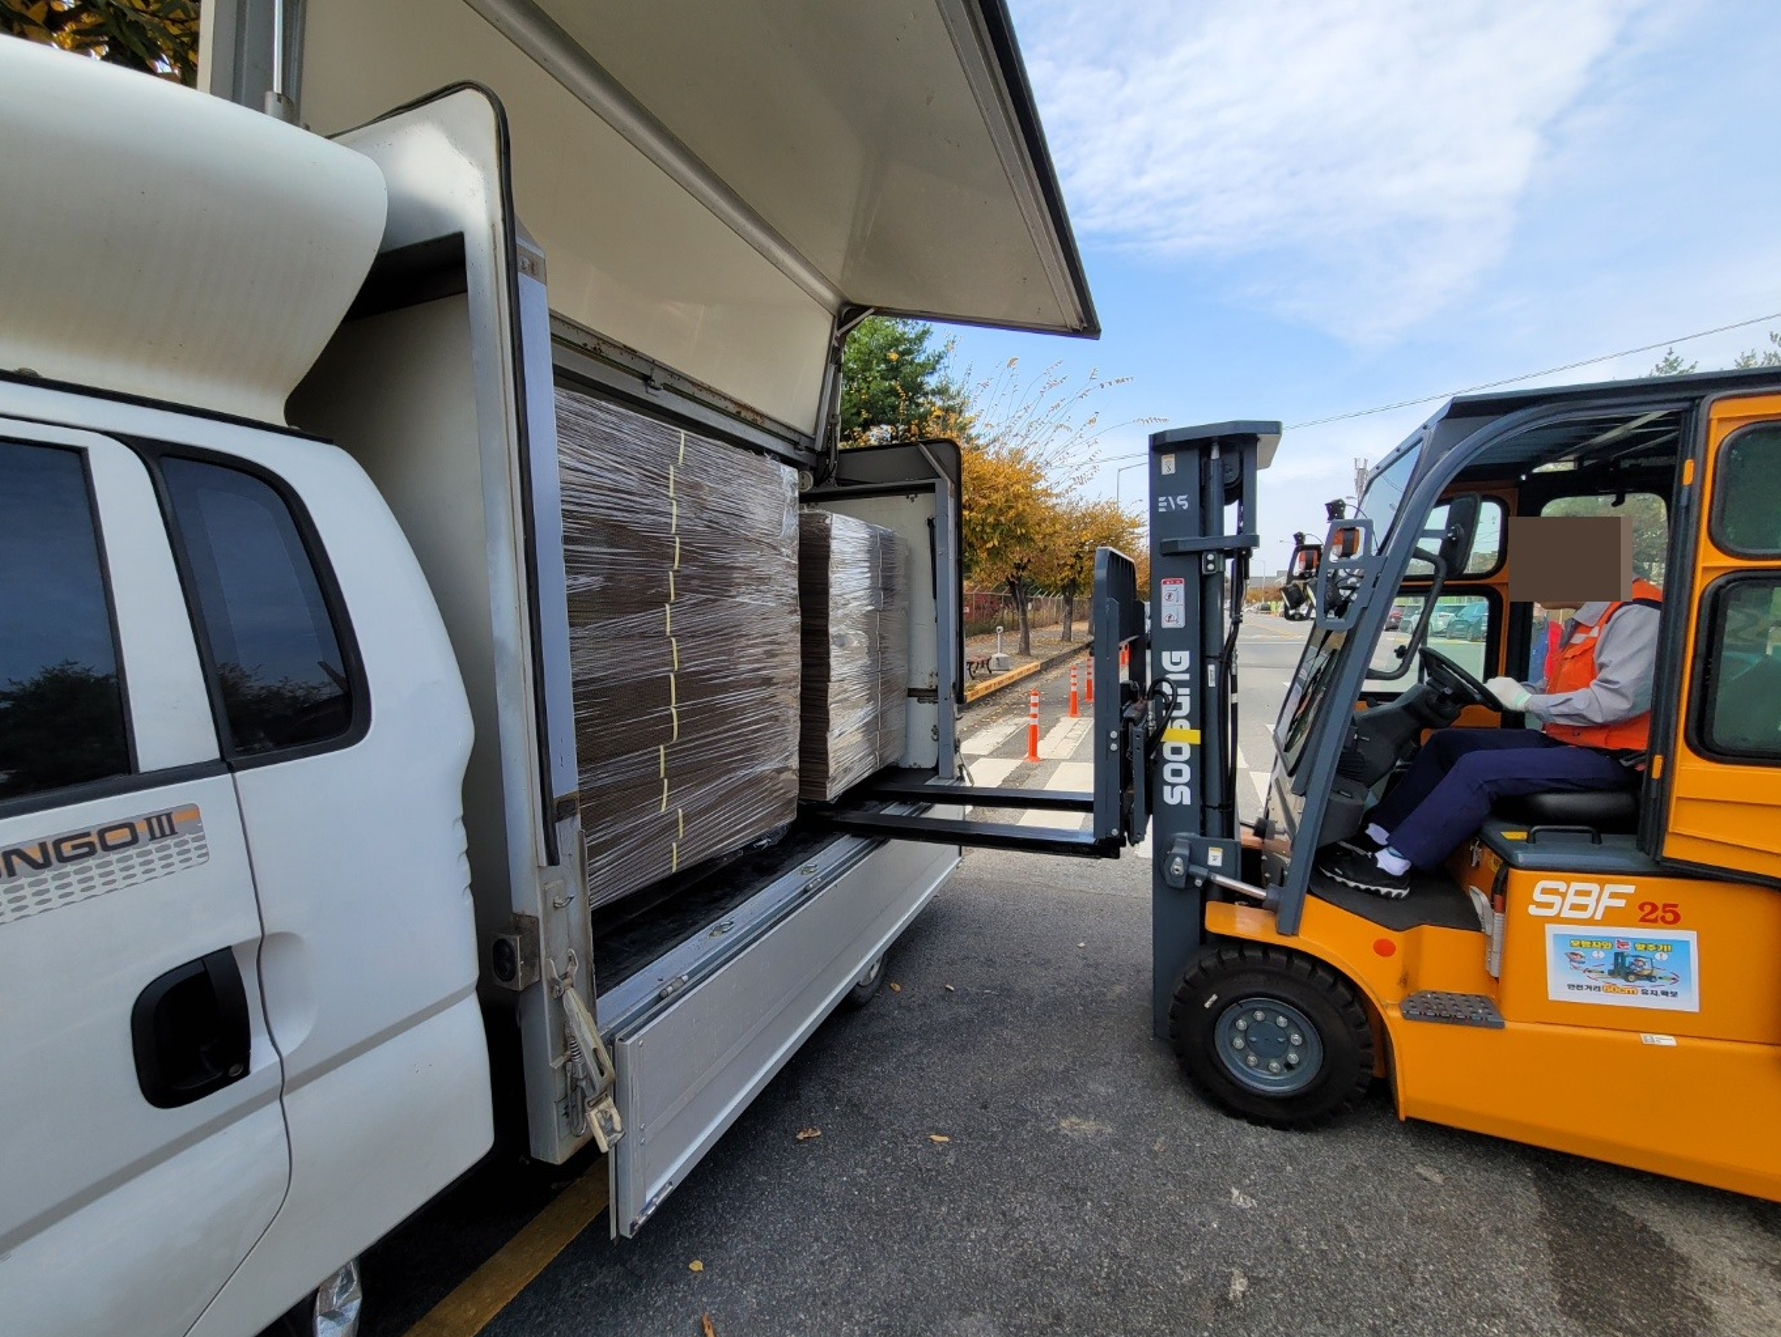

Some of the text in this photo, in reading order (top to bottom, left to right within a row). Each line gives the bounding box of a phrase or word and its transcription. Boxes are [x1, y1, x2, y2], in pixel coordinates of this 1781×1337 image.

[0, 812, 178, 879] NGO III
[1528, 880, 1681, 925] SBF 25
